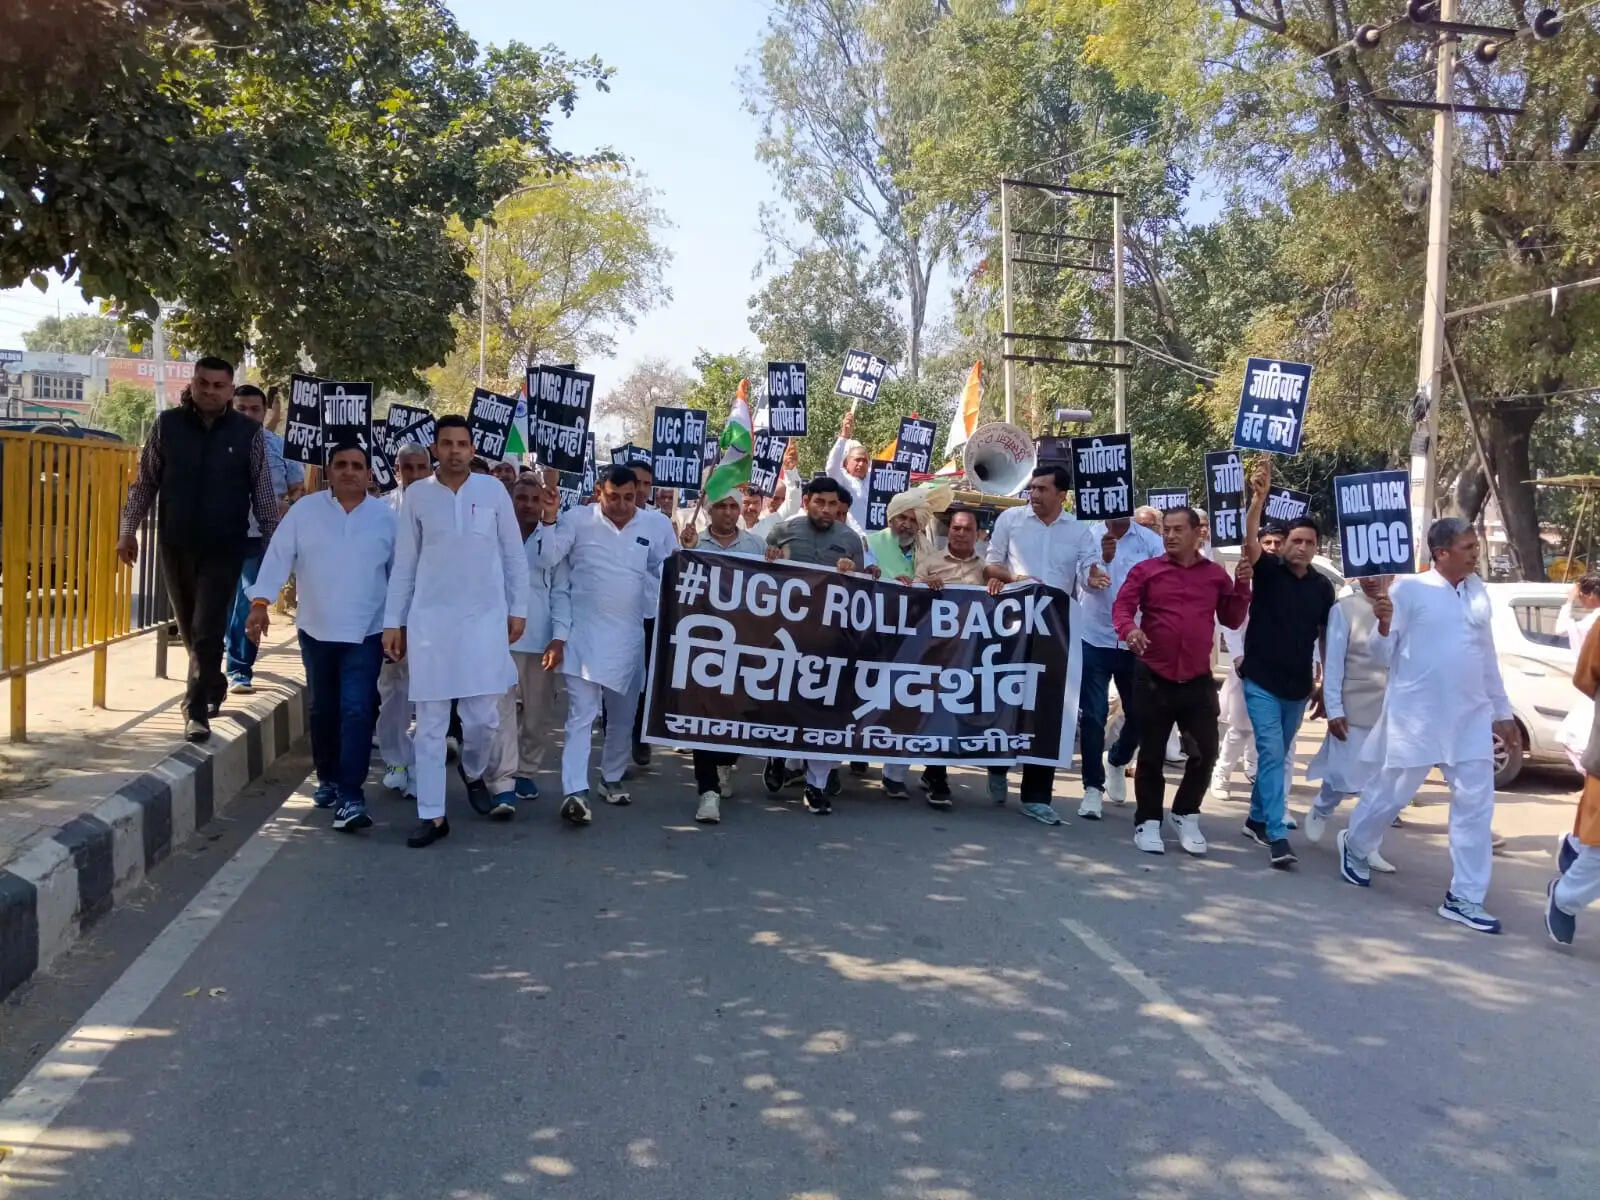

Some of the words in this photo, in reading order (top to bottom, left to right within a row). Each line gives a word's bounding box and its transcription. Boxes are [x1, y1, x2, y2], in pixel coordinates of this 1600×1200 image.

[769, 370, 788, 397] UGC
[789, 364, 805, 396] बिल
[846, 354, 868, 374] UGC
[293, 380, 318, 408] UGC
[540, 371, 562, 404] UGC
[562, 377, 591, 409] ACT
[1249, 363, 1305, 403] जातिवाद
[323, 385, 367, 426] जातिवाद
[389, 408, 407, 428] UGC
[474, 394, 513, 426] जातिवाद
[770, 400, 794, 432] वापिस
[795, 399, 805, 432] लो
[482, 429, 505, 457] करो
[656, 415, 682, 445] UGC
[683, 411, 705, 445] बिल
[901, 420, 933, 447] जातिवाद
[1241, 404, 1267, 443] बंद
[1266, 408, 1298, 448] करो
[654, 448, 685, 483] वापिस
[686, 453, 700, 484] लो
[910, 449, 928, 473] करो
[1077, 438, 1127, 474] जातिवाद
[762, 465, 777, 494] लो
[873, 463, 907, 493] जातिवाद
[870, 496, 887, 526] बंद
[1079, 480, 1100, 515] बंद
[1102, 476, 1129, 514] करो
[1265, 490, 1307, 521] जातिवाद
[1341, 483, 1372, 515] ROLL
[1372, 480, 1407, 511] BACK
[1214, 500, 1237, 540] बंद
[1346, 520, 1410, 567] UGC
[675, 561, 811, 622] #UGC
[821, 583, 917, 636] ROLL
[931, 594, 1054, 640] BACK
[669, 613, 849, 707] विरोध
[851, 642, 1047, 721] प्रदर्शन
[664, 712, 799, 744] सामान्य
[802, 723, 856, 748] वर्ग
[860, 725, 953, 753] जिला
